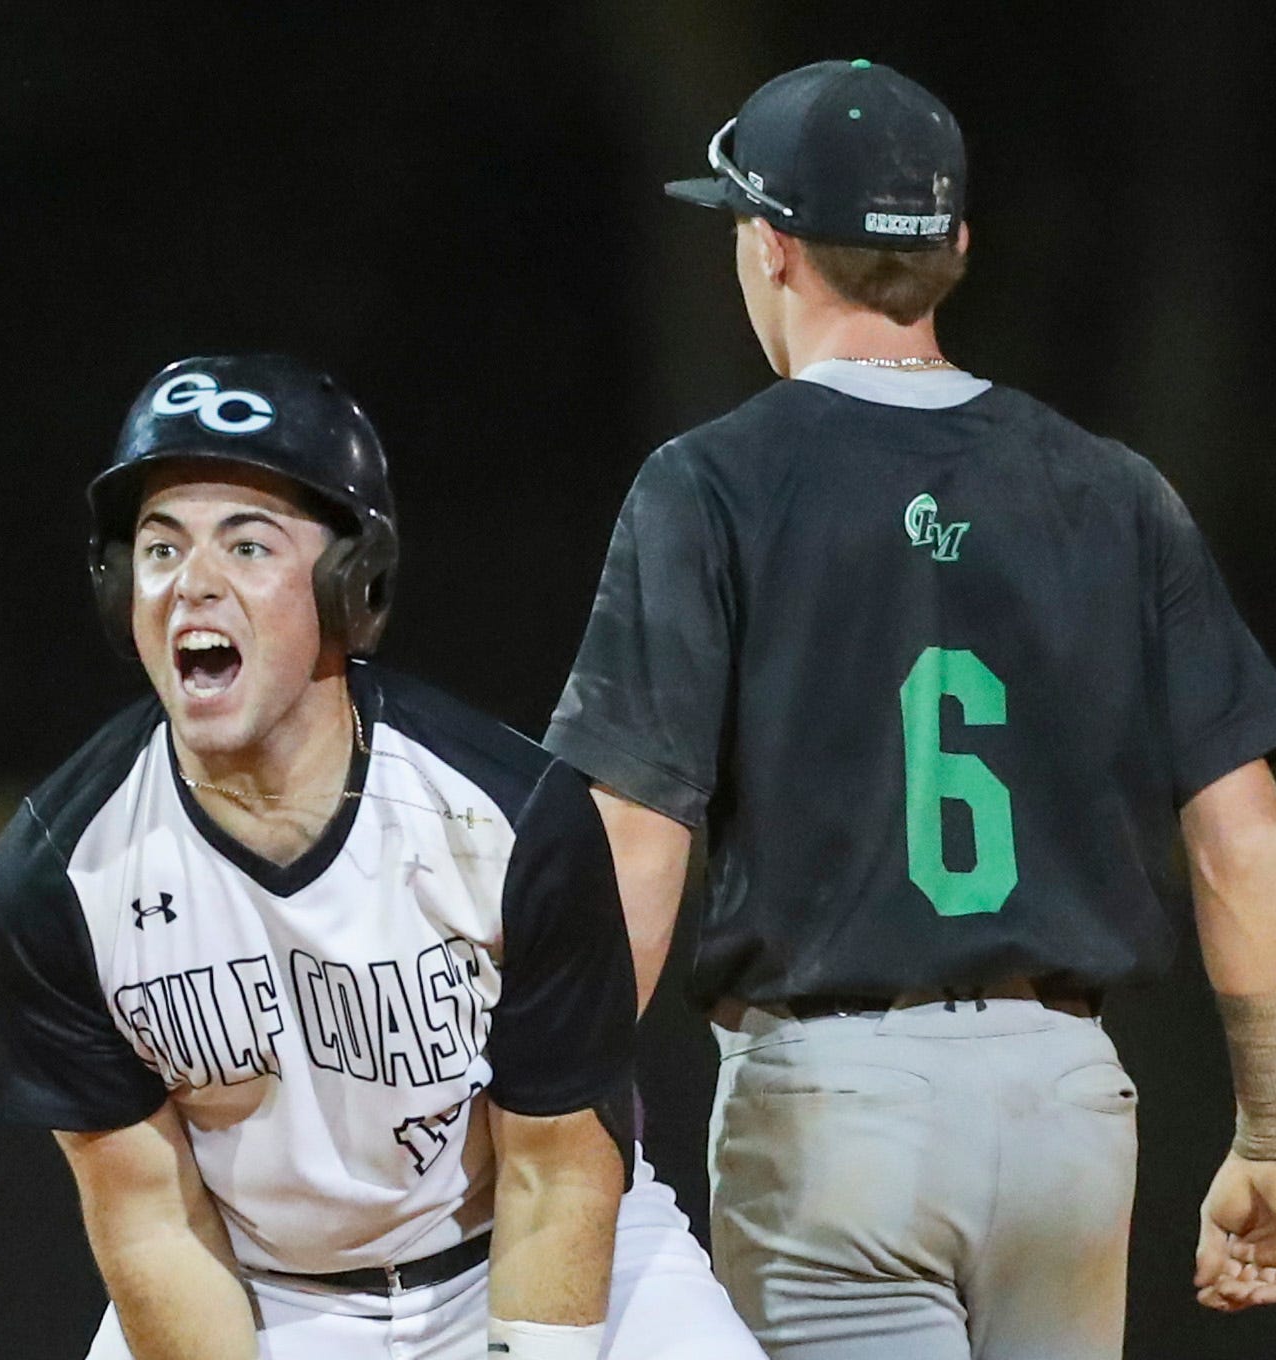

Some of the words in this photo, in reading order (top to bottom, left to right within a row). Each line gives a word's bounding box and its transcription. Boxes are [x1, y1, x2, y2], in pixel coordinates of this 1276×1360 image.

[152, 372, 275, 434] GC
[899, 645, 1019, 917] 6
[114, 953, 285, 1090] GULF
[289, 935, 480, 1088] COAST
